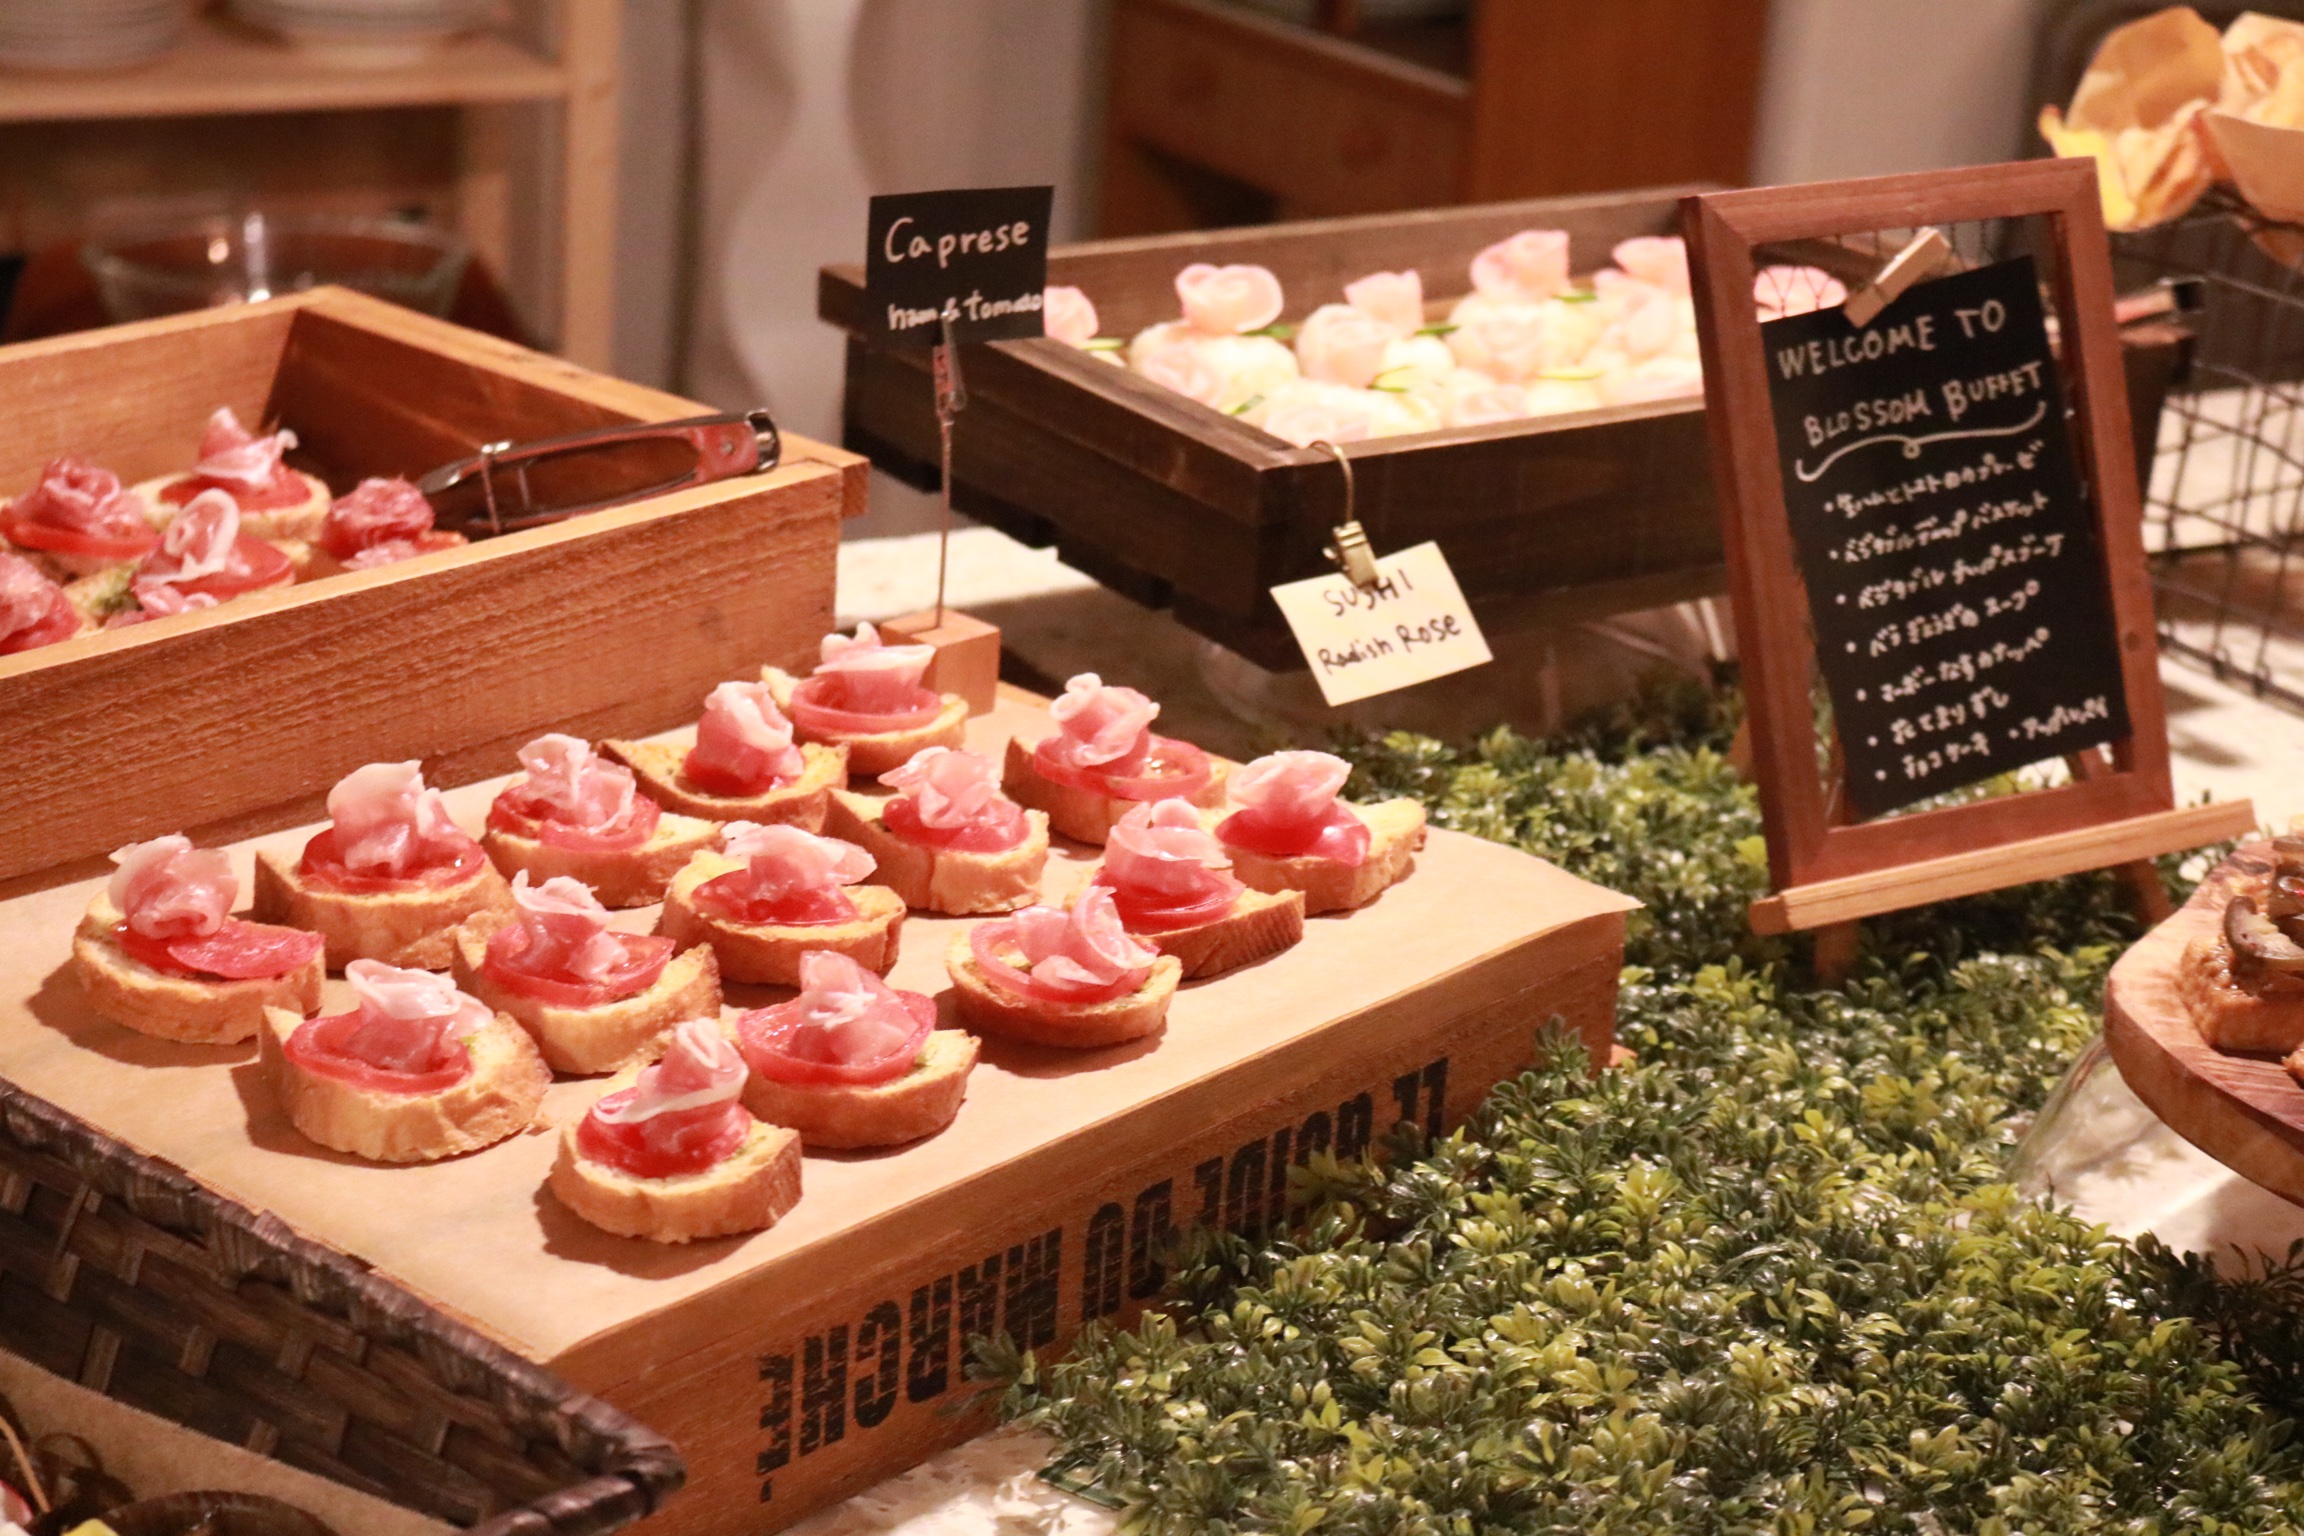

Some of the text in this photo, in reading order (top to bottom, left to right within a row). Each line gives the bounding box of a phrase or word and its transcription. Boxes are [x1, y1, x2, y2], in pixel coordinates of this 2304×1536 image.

[884, 216, 1031, 269] Caprese
[888, 303, 938, 331] ham
[963, 289, 1043, 322] tomato
[1777, 299, 2006, 380] WELCOME TO
[1803, 360, 2043, 448] BLOSSOM BUFFET
[1322, 568, 1414, 617] SUSHI
